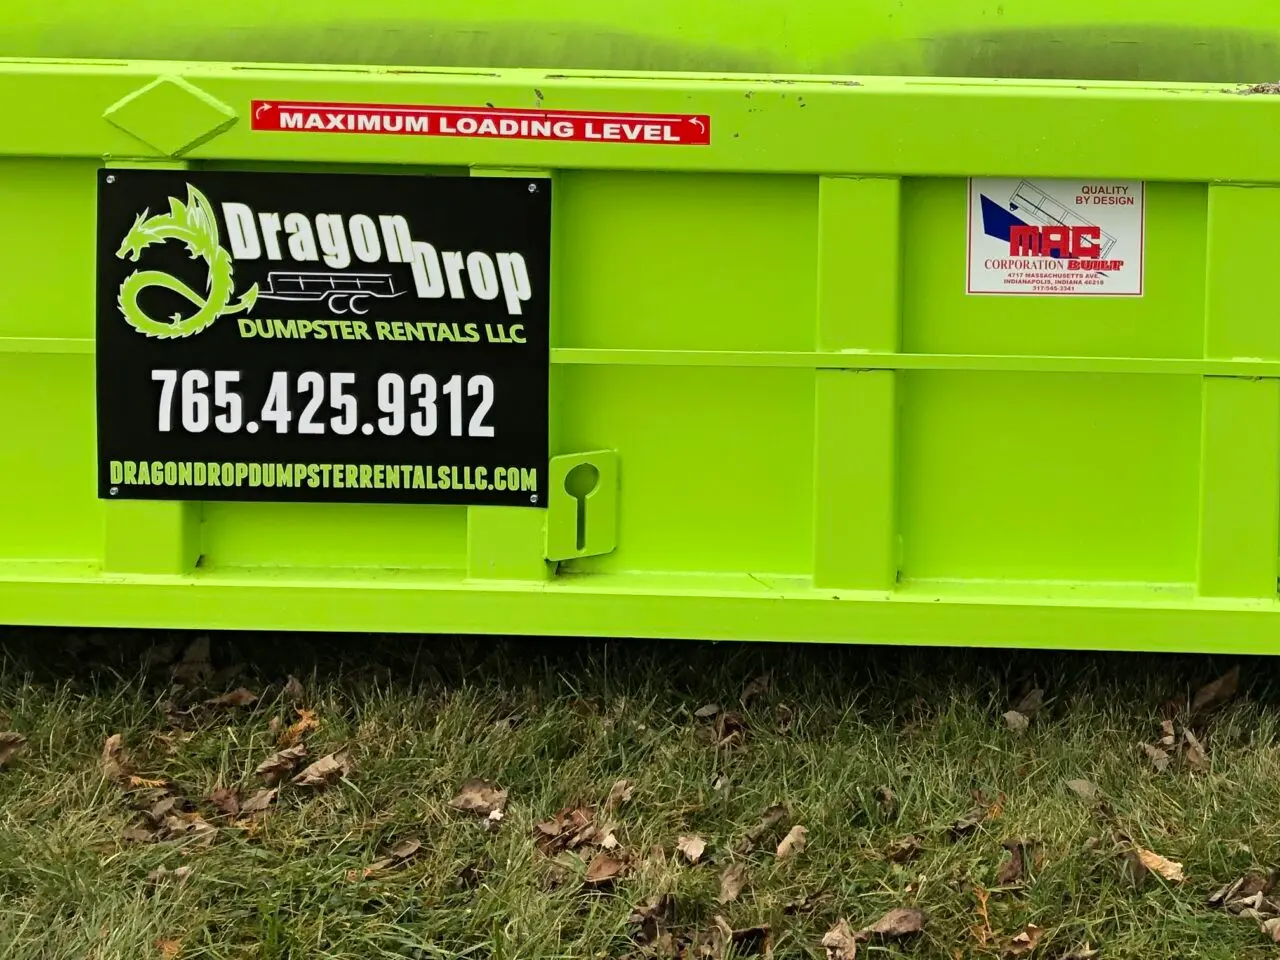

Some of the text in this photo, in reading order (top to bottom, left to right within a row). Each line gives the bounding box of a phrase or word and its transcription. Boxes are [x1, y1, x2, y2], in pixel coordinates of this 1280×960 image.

[280, 112, 681, 141] MAXIMUM LOADING LEVEL
[1075, 196, 1134, 205] BY DESIGN
[1081, 185, 1129, 195] QUALITY
[1010, 225, 1101, 260] MAC
[984, 259, 1124, 272] CORPORATION BUILT
[237, 319, 527, 343] DUMPSTER RENTALS LLC
[151, 369, 495, 437] 765.425.9312
[110, 460, 537, 492] DRAGONDROPDUMPSTERRENTALSLLC.COM
